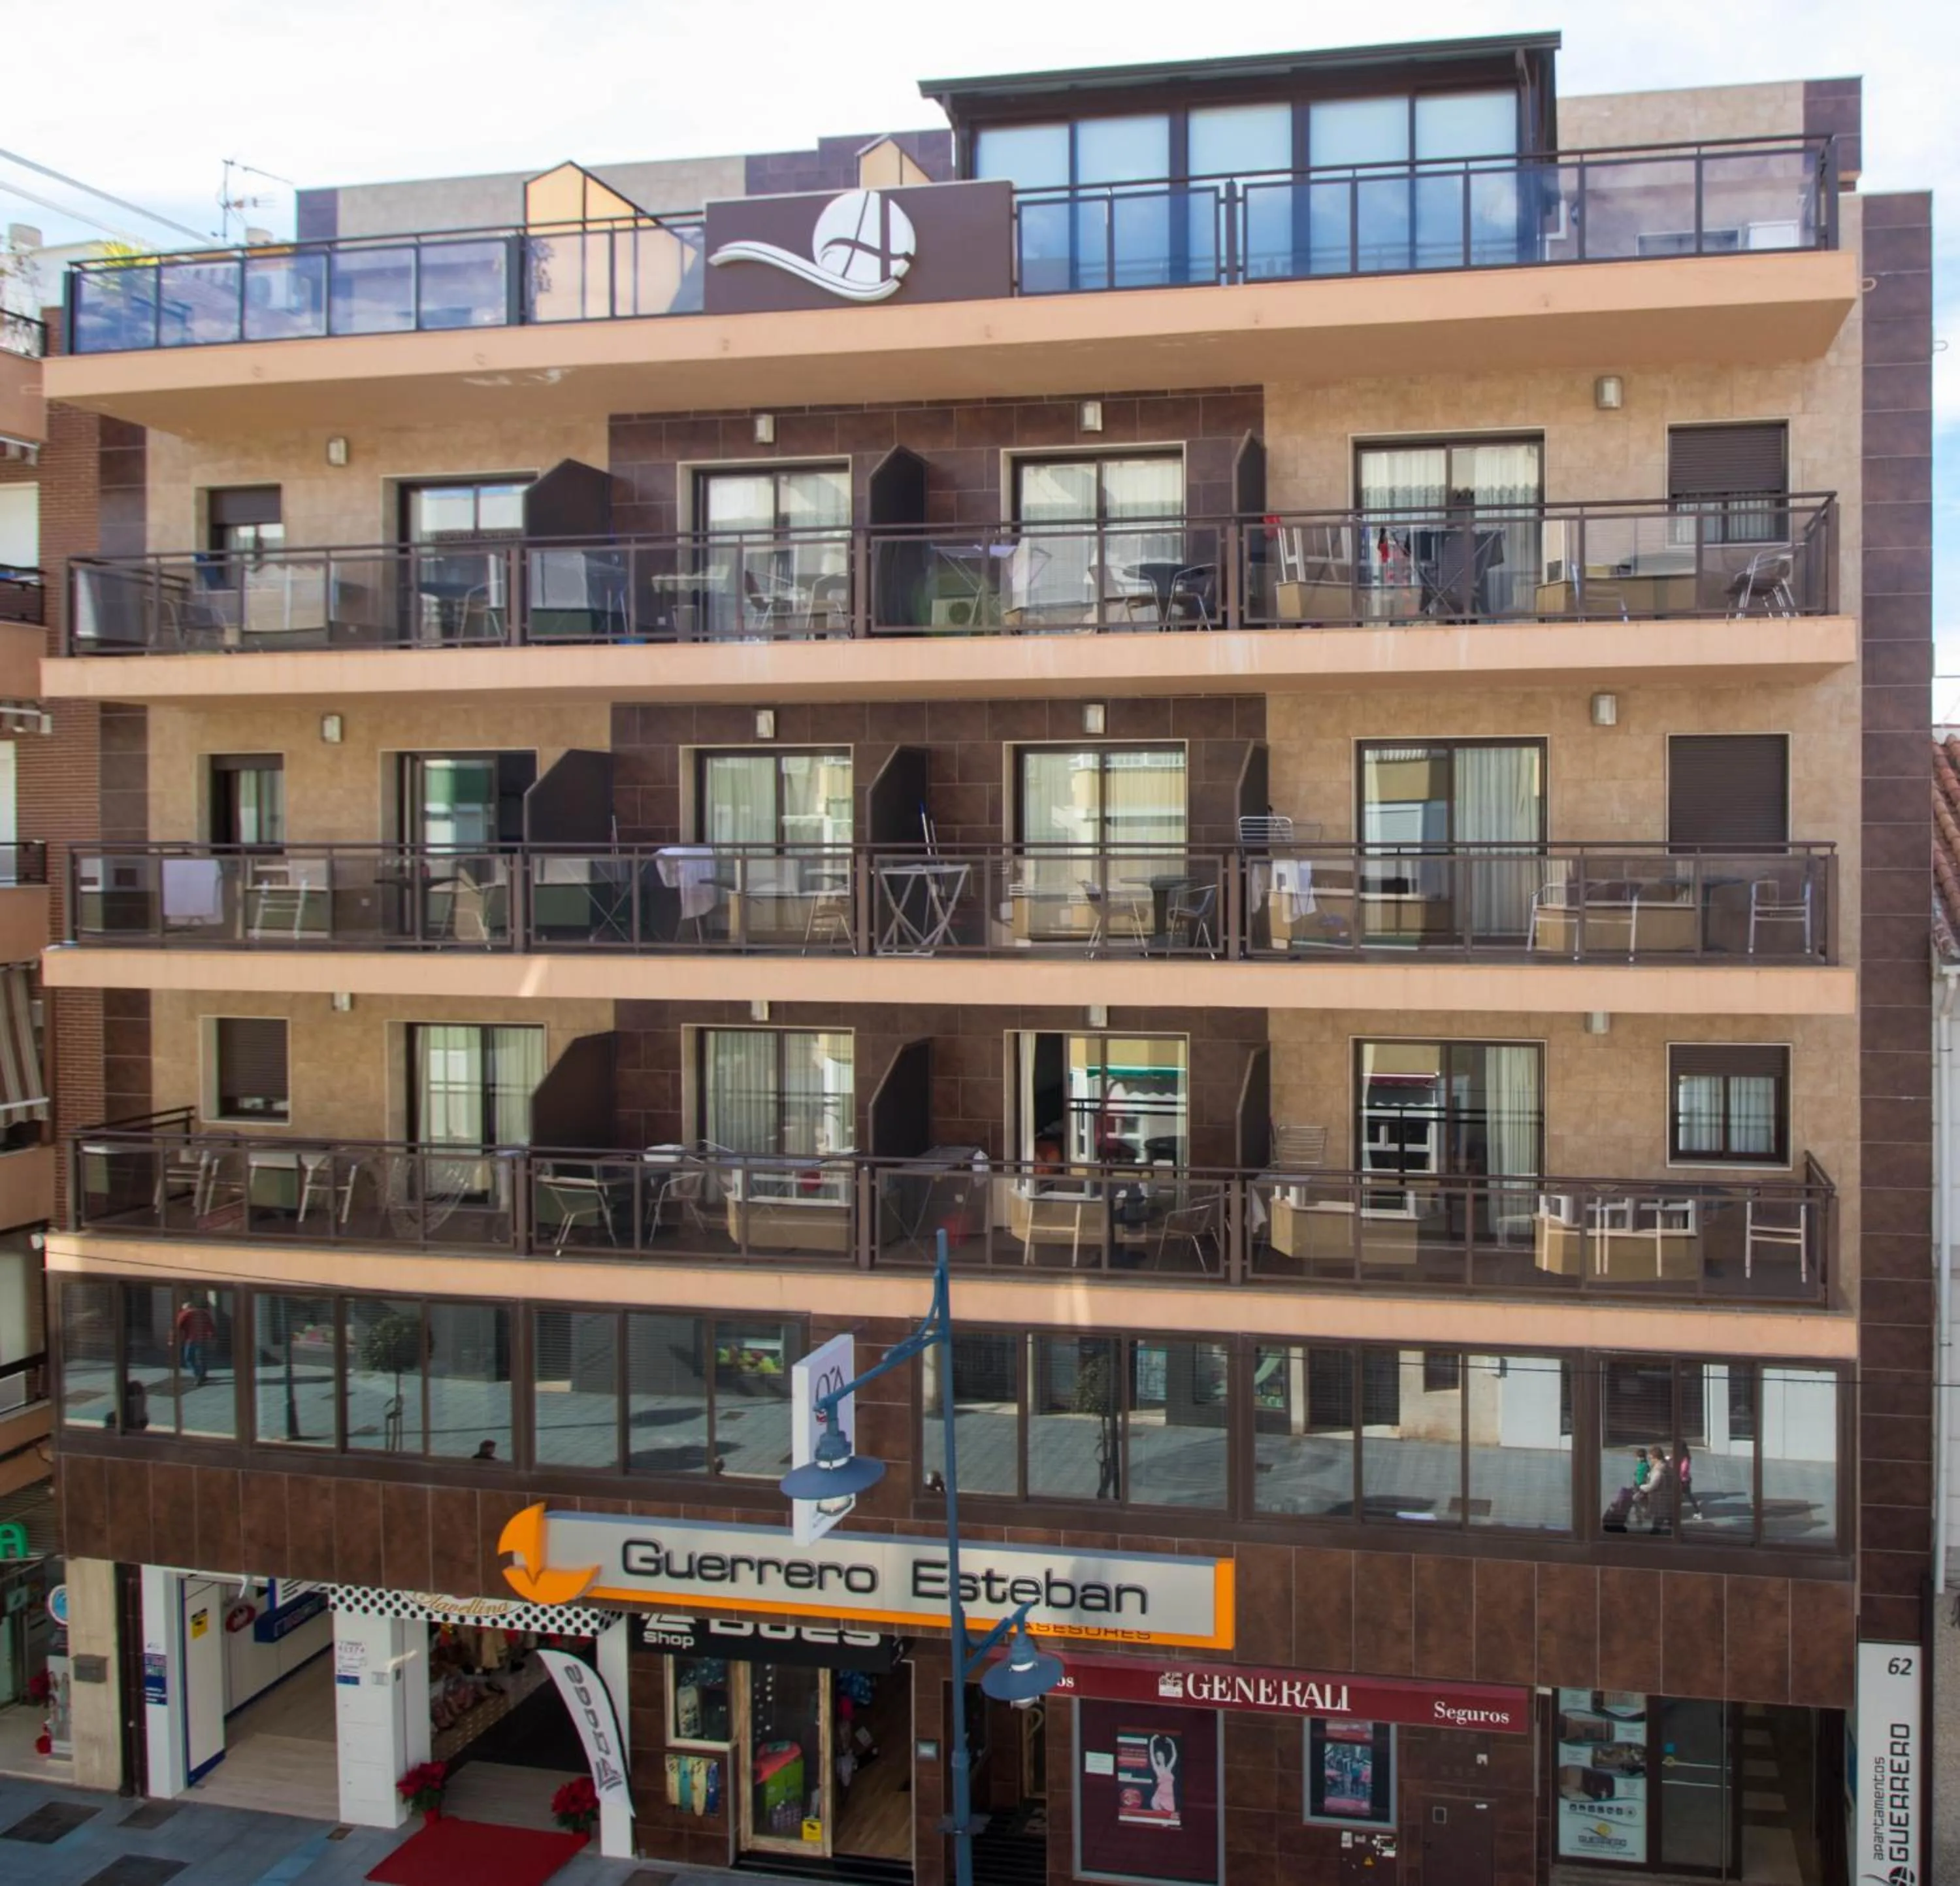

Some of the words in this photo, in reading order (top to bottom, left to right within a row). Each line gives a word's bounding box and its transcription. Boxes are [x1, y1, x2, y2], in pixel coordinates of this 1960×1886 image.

[621, 1538, 878, 1595] Guerrero
[911, 1559, 1149, 1615] Esteban
[642, 1630, 695, 1650] Shop
[1887, 1657, 1913, 1676] 62
[1186, 1672, 1352, 1712] GENERALI
[1433, 1700, 1510, 1725] Seguros
[1872, 1756, 1886, 1861] apartamentos
[1888, 1723, 1910, 1862] GUERRERO
